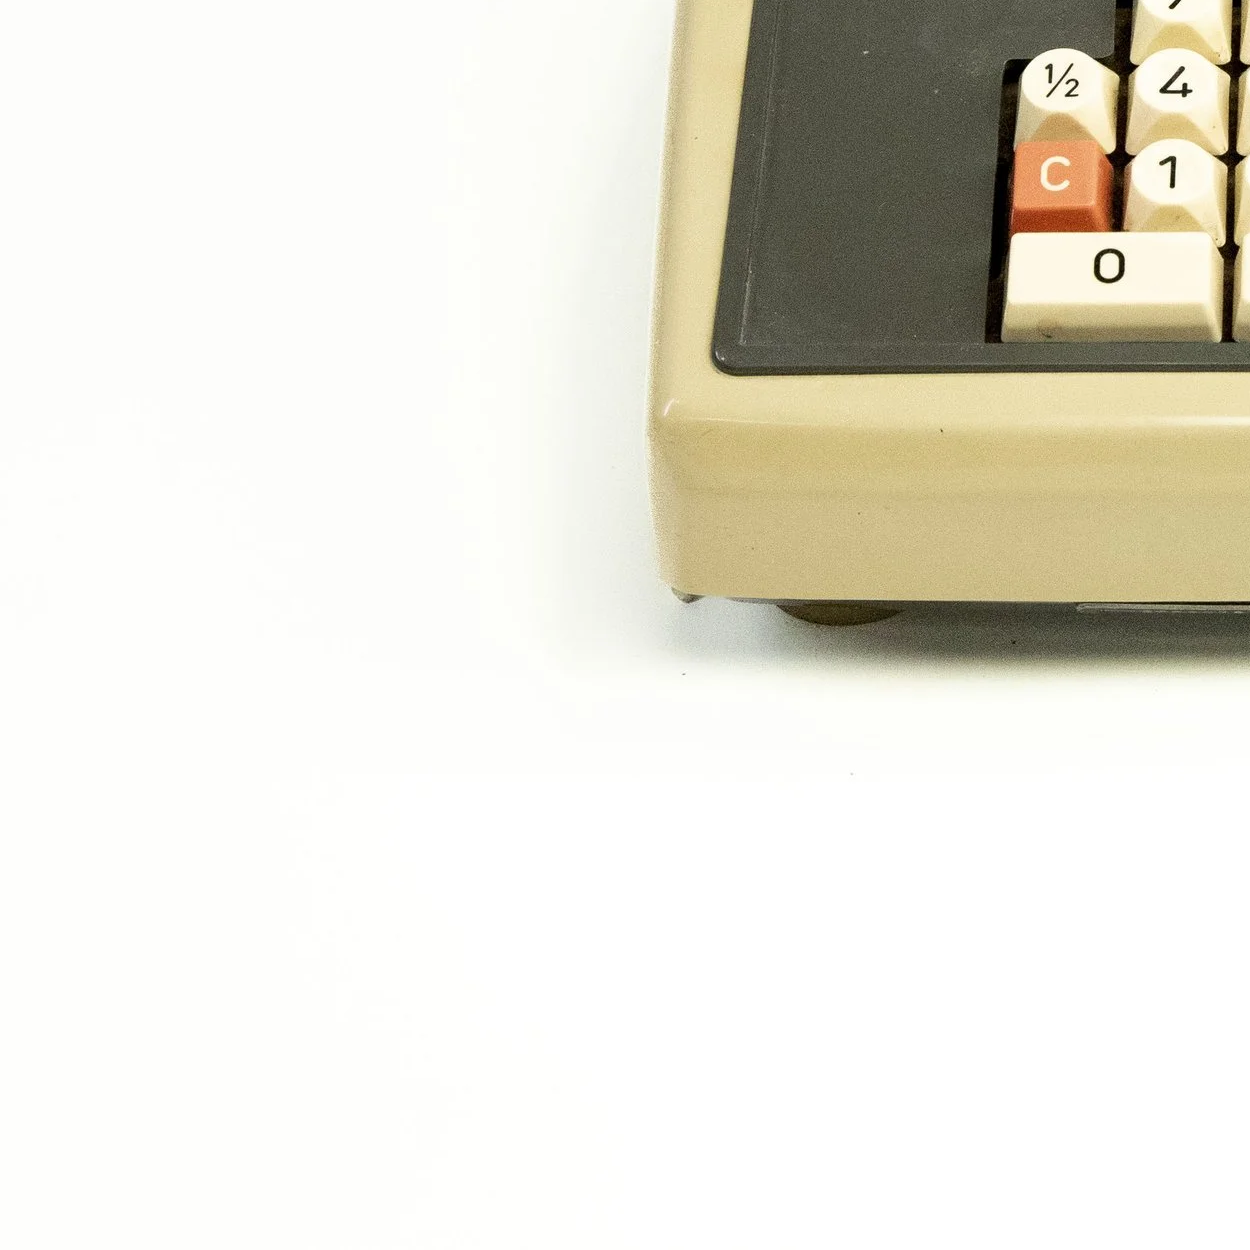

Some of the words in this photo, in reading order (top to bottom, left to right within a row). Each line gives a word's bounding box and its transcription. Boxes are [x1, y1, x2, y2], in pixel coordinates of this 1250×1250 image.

[1160, 66, 1192, 97] 4
[1040, 156, 1072, 191] C
[1159, 156, 1177, 188] 1
[1094, 249, 1125, 283] 0
